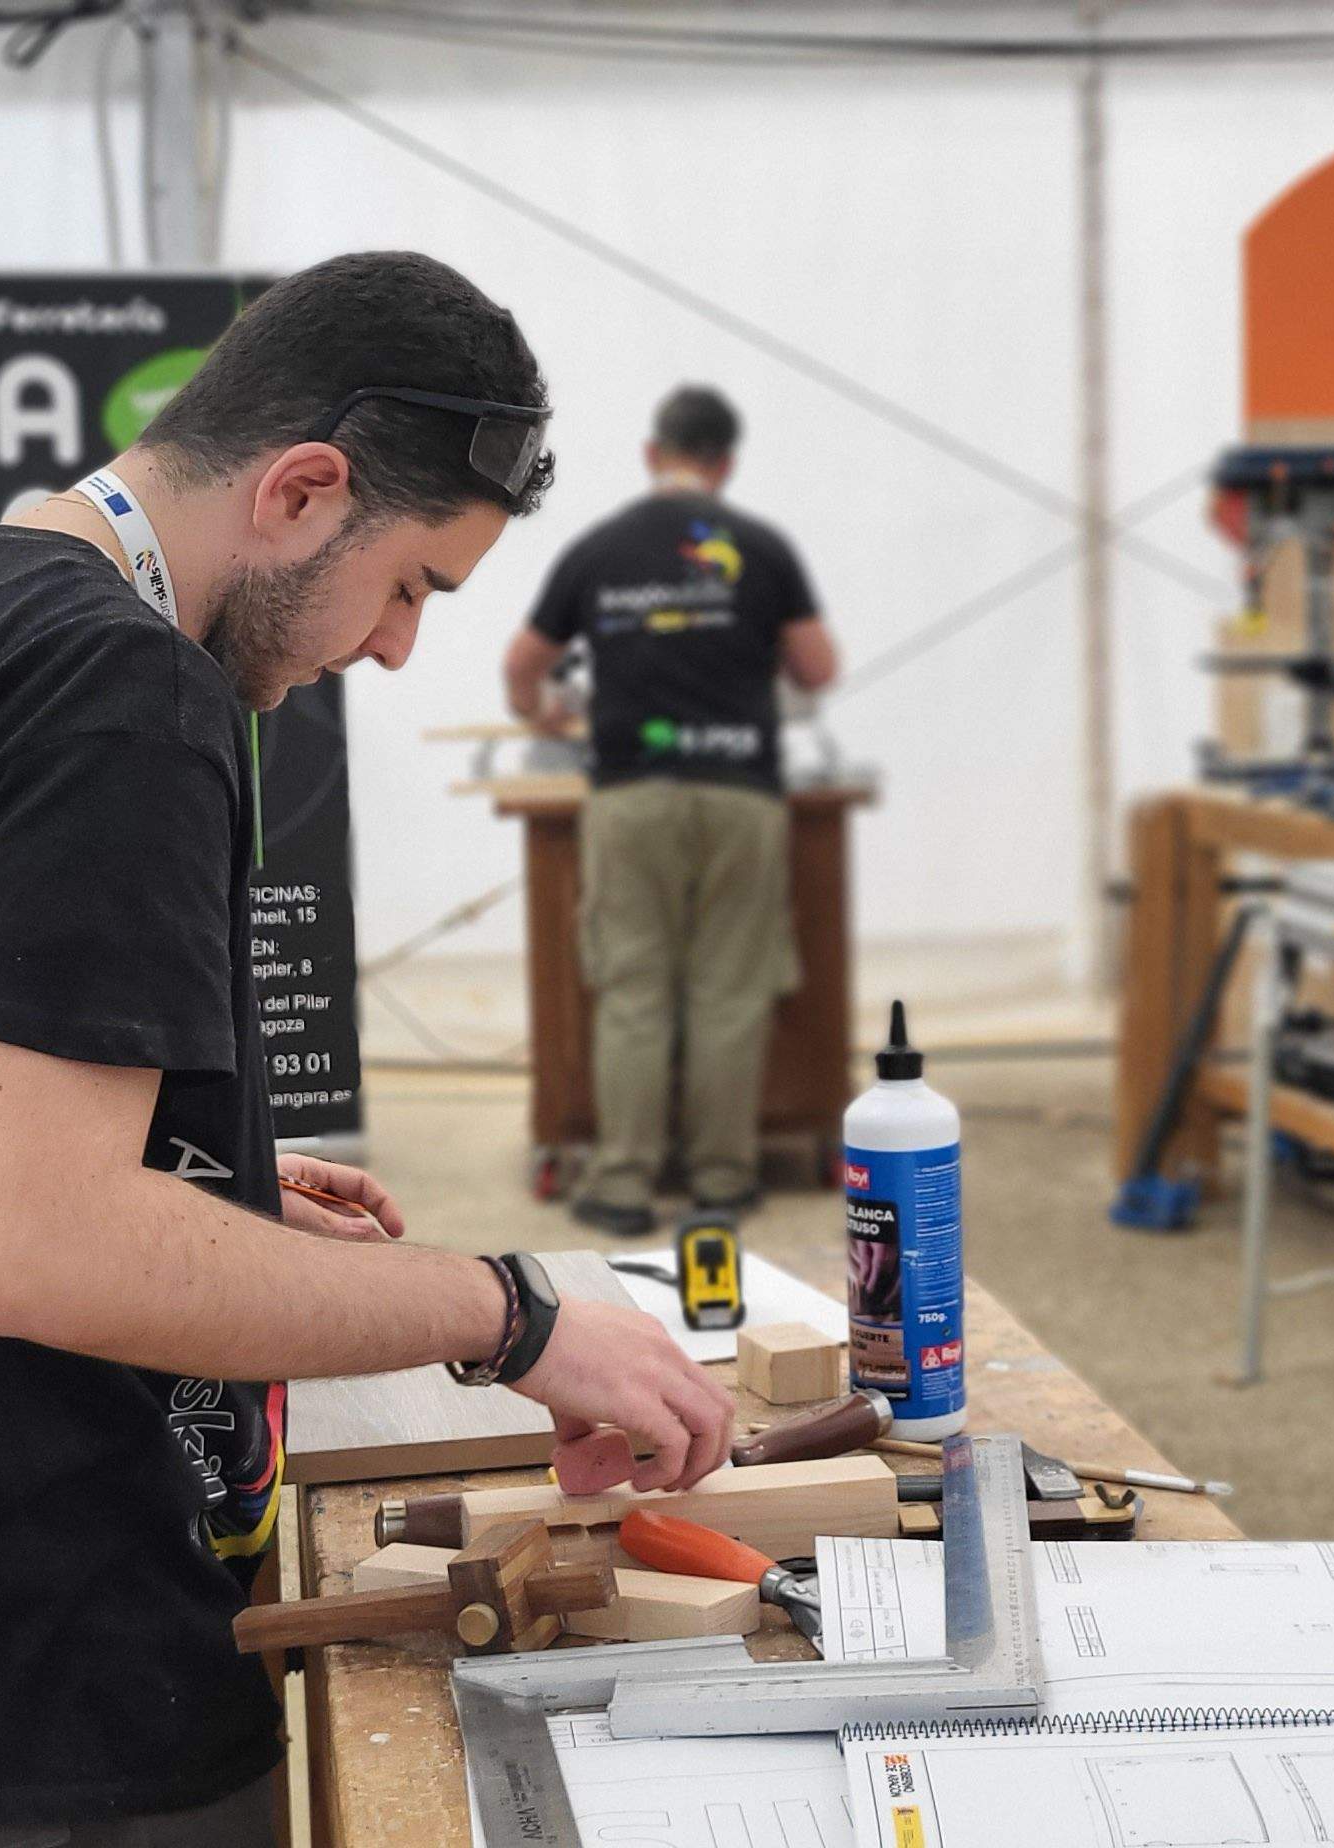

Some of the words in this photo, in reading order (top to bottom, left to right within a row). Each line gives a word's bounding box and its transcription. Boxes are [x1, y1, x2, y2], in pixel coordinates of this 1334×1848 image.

[297, 906, 317, 924] 15
[300, 958, 313, 976] 8
[294, 994, 332, 1011] Pilar
[272, 1054, 301, 1076] 93
[305, 1052, 331, 1074] 01
